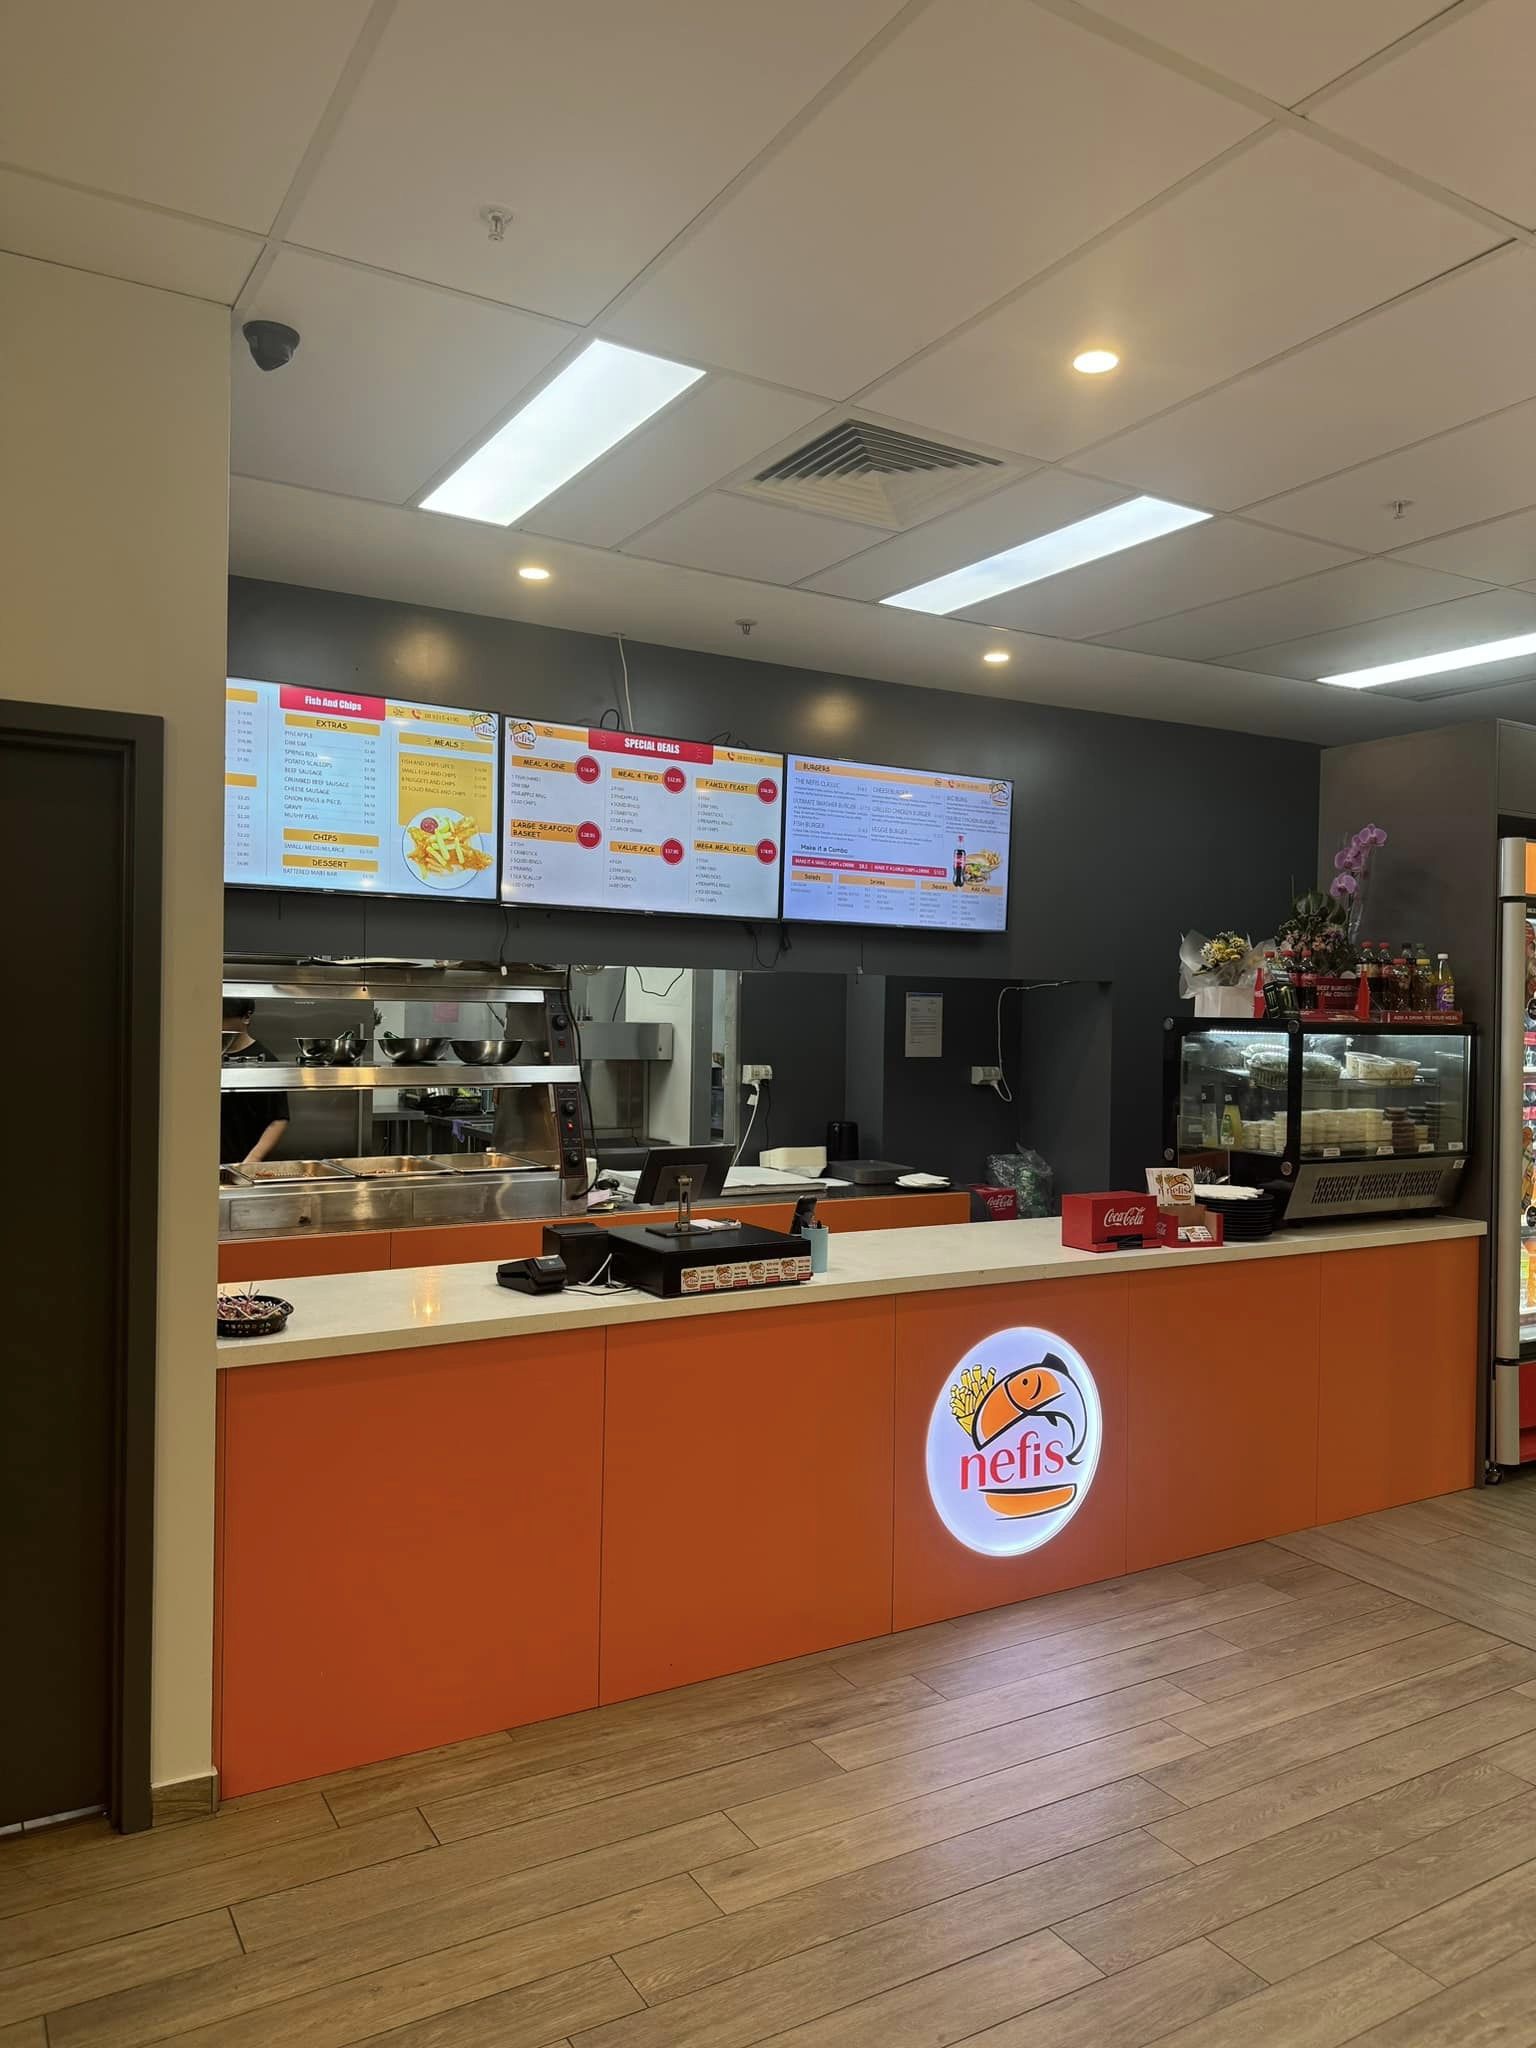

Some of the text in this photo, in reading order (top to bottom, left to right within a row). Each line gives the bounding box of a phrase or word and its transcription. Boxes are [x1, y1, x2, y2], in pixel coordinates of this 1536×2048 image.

[305, 695, 362, 711] Fish And Chips
[316, 719, 348, 730] EXTRAS
[434, 739, 459, 748] MEALS
[624, 737, 680, 754] SPECIAL DEALS
[284, 758, 333, 768] POTATO SCALLOPS
[523, 759, 541, 767] MEAL
[550, 762, 566, 770] ONE
[803, 763, 831, 773] BURGERS
[298, 768, 322, 776] SAUSAGE
[325, 780, 349, 788] SAUSAGE
[705, 781, 748, 791] FAMILY FEAST
[795, 777, 804, 785] THE
[284, 785, 330, 795] CHEESE SAUSAGE
[512, 821, 574, 833] LARGE SEAFOOD
[805, 821, 825, 829] BURGER
[312, 833, 338, 842] CHIPS
[512, 829, 541, 837] BASKET
[617, 844, 656, 853] VALUE PACK
[732, 845, 747, 853] DEAL
[312, 858, 348, 868] DESSERT
[1166, 1185, 1189, 1195] nefis
[1104, 1207, 1146, 1227] Coca-Cola
[960, 1430, 1064, 1490] nefis
